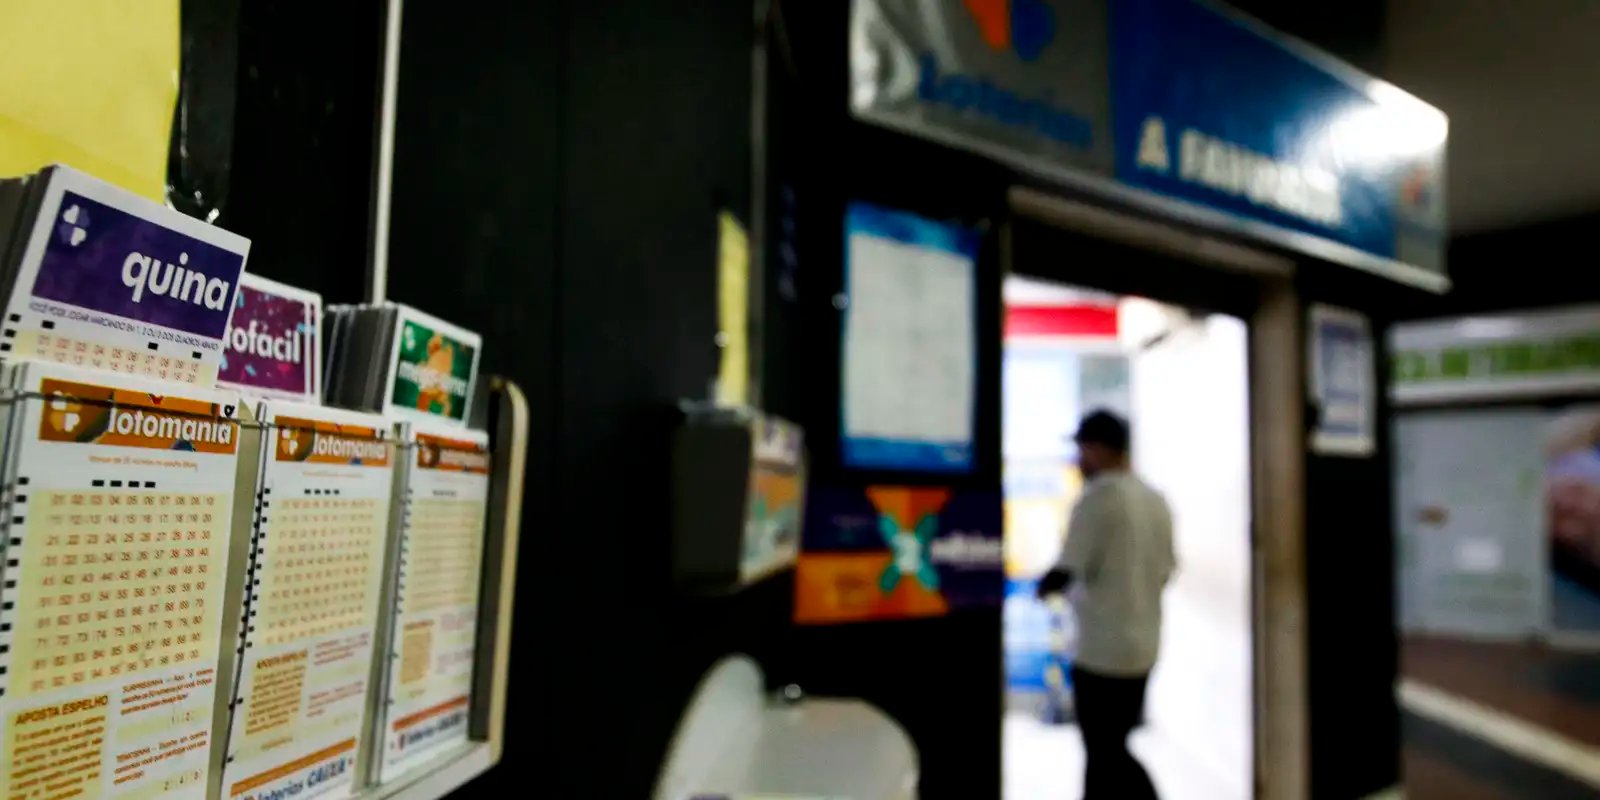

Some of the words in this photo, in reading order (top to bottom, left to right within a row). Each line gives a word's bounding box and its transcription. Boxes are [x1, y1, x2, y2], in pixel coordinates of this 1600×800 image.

[1136, 114, 1169, 170] A
[121, 251, 230, 311] quina
[107, 407, 232, 444] lotomania
[312, 432, 386, 460] lotomania
[15, 706, 60, 725] APOSTA
[61, 694, 108, 715] ESPELHO
